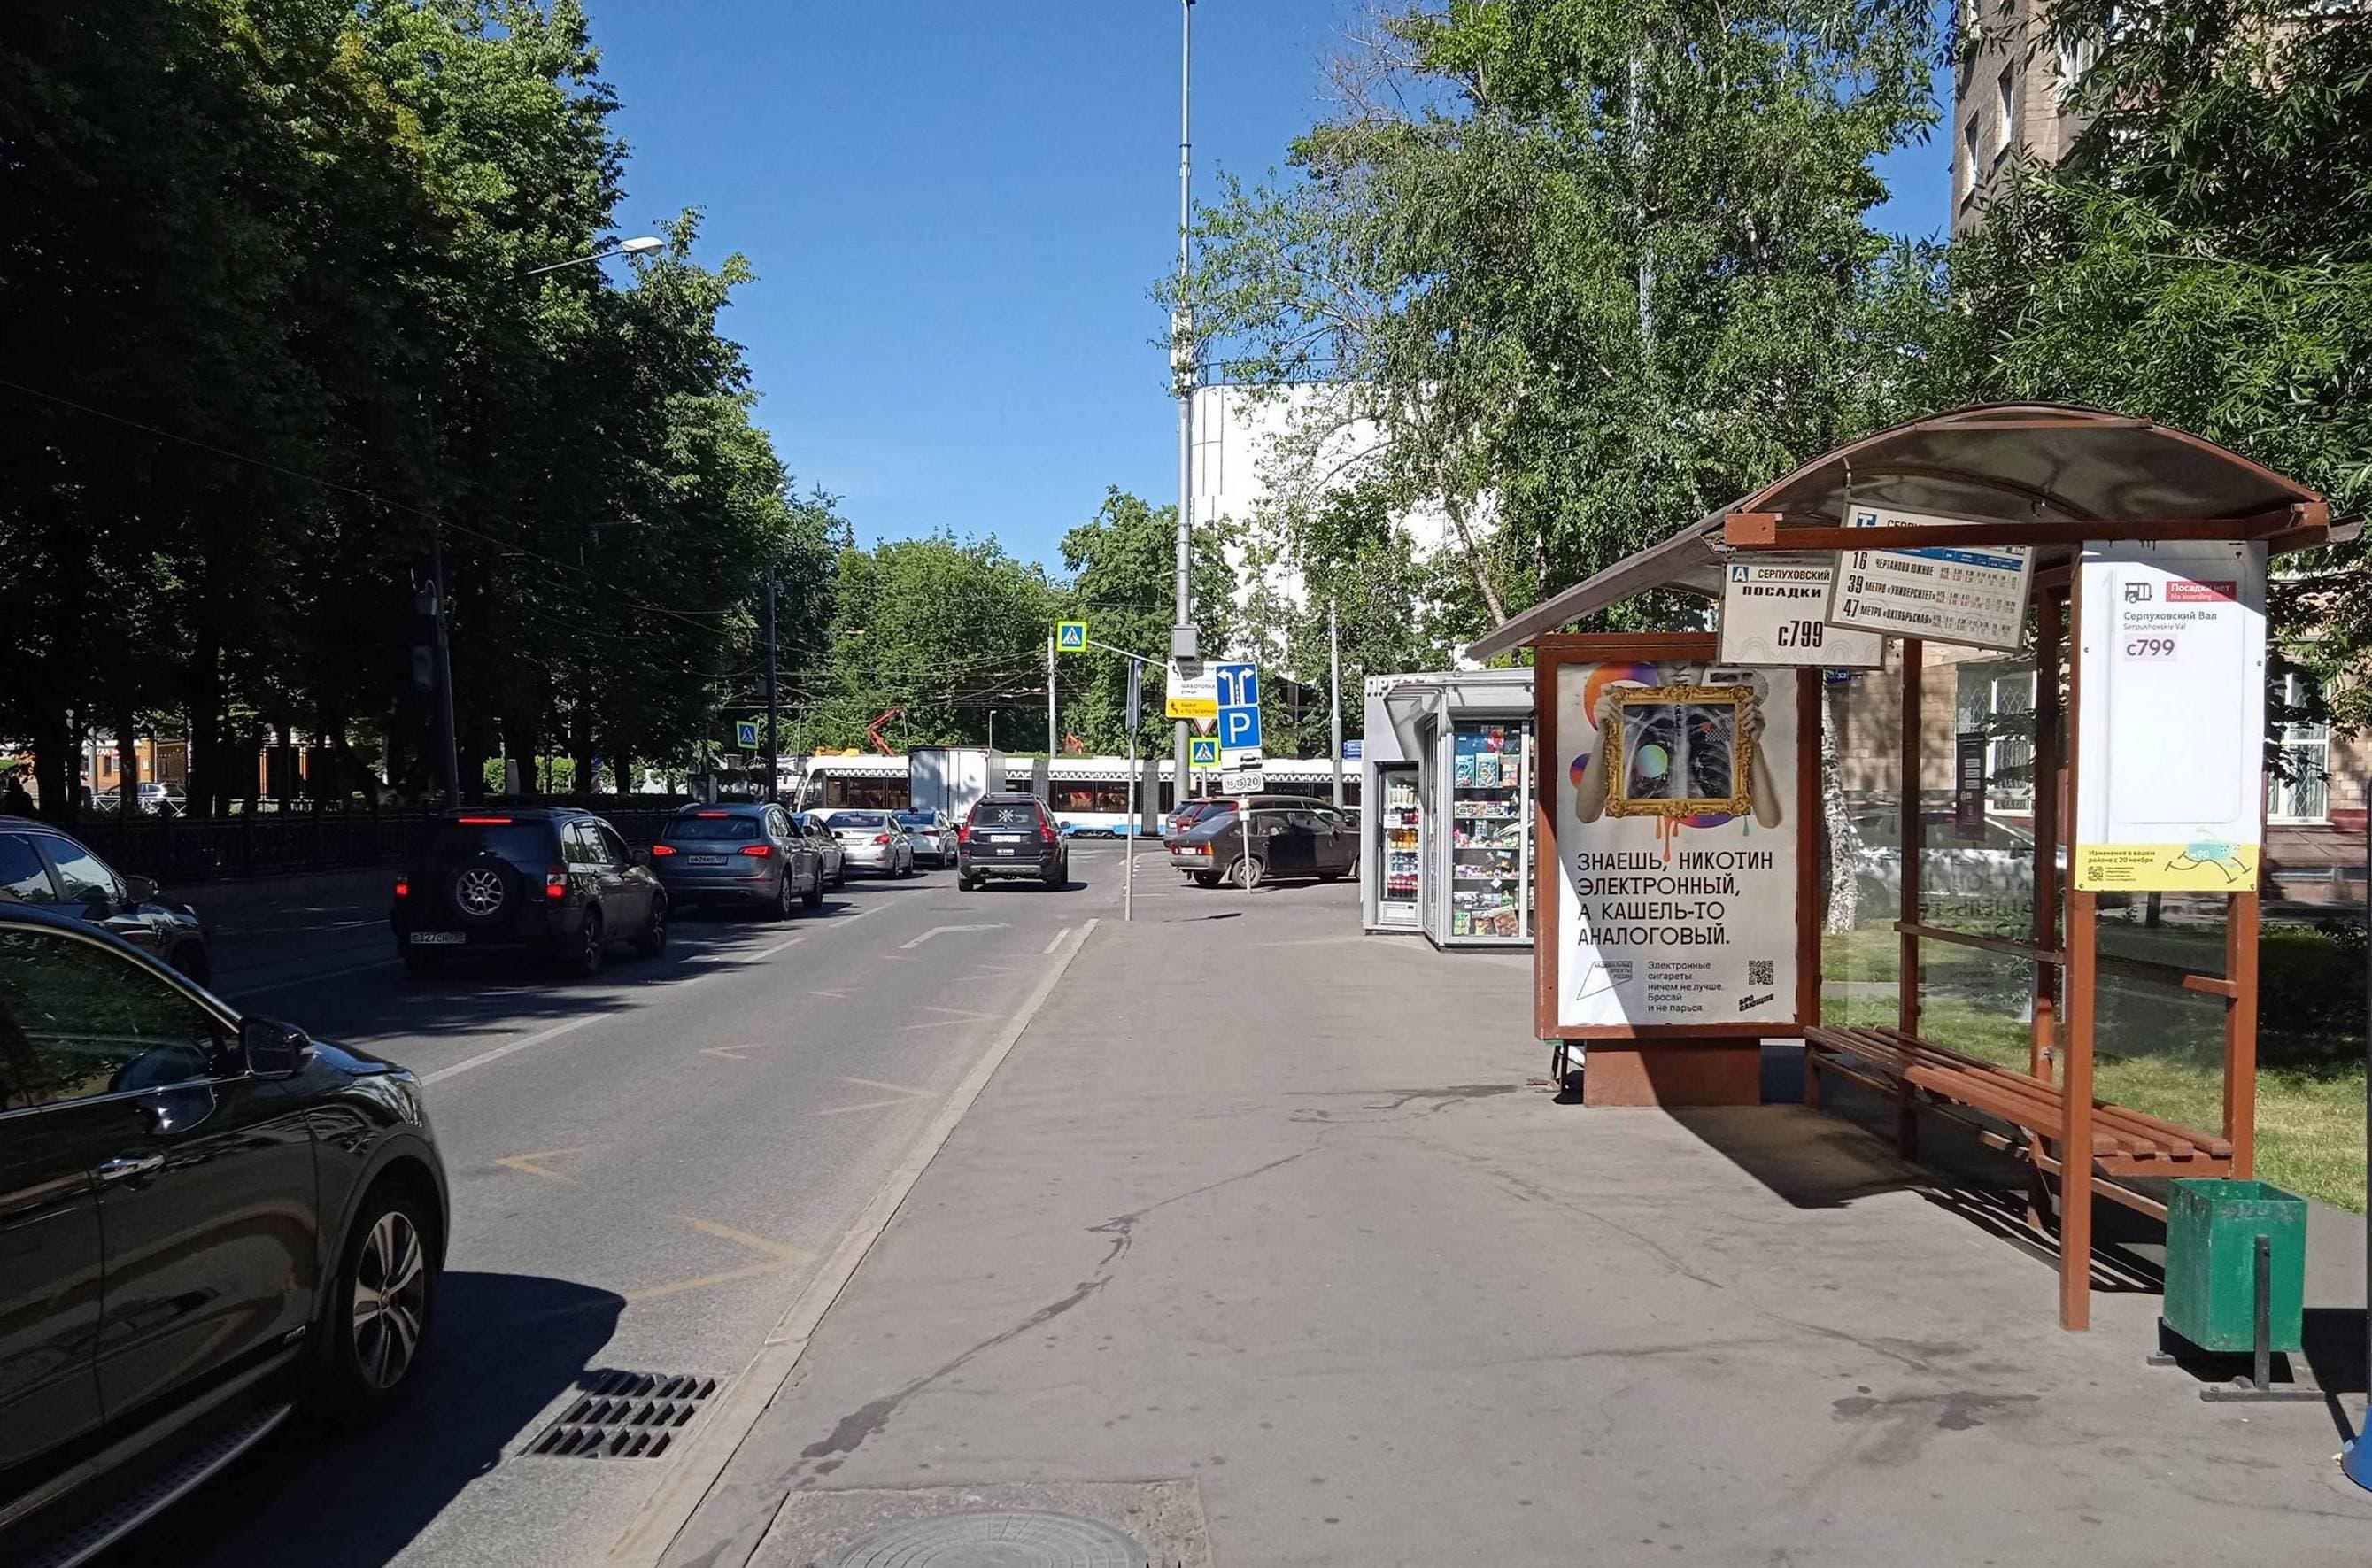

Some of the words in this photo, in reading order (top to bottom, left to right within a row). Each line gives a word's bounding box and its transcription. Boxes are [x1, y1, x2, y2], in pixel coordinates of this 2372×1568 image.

[1853, 552, 1868, 569] 16
[1875, 558, 1910, 573] ЧЕРТАНОВО
[1910, 564, 1935, 575] ЮЖНОЕ
[1758, 568, 1830, 581] СЕРПУХОВСКИЙ
[1742, 586, 1821, 598] ПОСАДКИ
[1847, 575, 1864, 594] 39
[1865, 581, 1887, 593] МЕТРО
[2171, 583, 2212, 592] Посадки
[1843, 599, 1860, 618] 47
[1860, 606, 1882, 617] МЕТРО
[2123, 612, 2196, 622] Серпуховский
[1778, 621, 1824, 648] с799
[2126, 639, 2175, 656] с799
[1228, 712, 1250, 744] P
[1247, 776, 1259, 787] 20
[1578, 852, 1668, 872] ЗНАЕШЬ,
[1679, 851, 1773, 870] НИКОТИН
[1578, 873, 1741, 897] ЭЛЕКТРОННЫЙ,
[1578, 903, 1591, 921] А
[1602, 901, 1725, 920] КАШЕЛЬ-ТО
[1578, 923, 1731, 946] АНАЛОГОВЫЙ.
[1648, 961, 1711, 970] Электронные
[1693, 983, 1724, 993] лучше.
[1648, 993, 1682, 1002] Бросай
